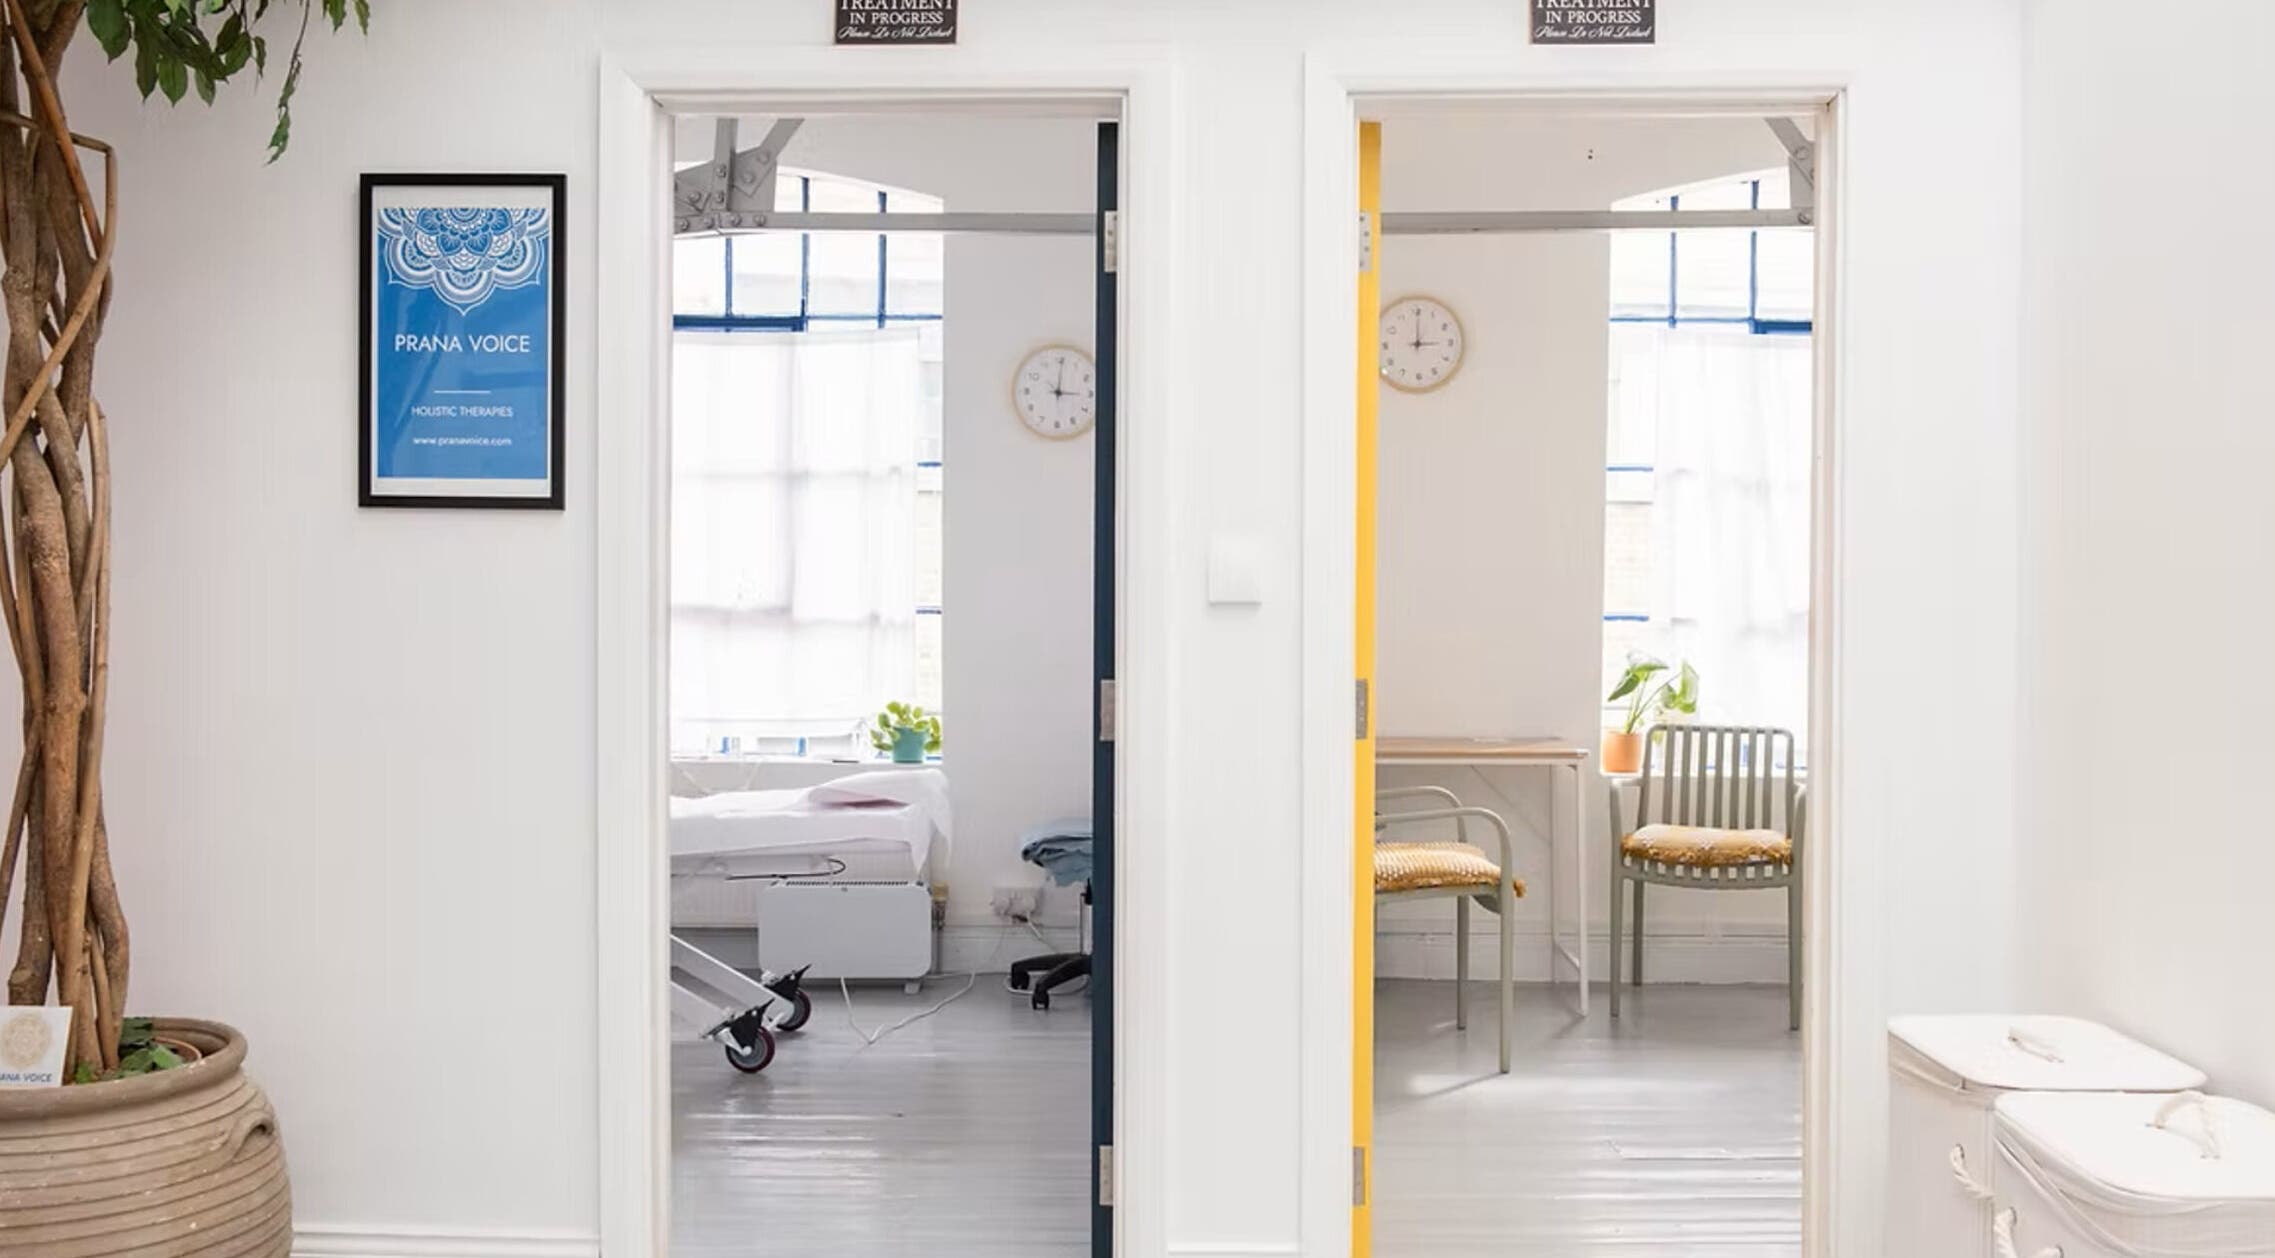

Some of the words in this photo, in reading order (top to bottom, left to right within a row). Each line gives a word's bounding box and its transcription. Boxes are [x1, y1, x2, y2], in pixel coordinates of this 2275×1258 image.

[840, 0, 953, 9] TREATMENT
[1536, 0, 1650, 8] TREATMENT
[850, 12, 865, 24] IN
[871, 11, 944, 24] PROGRESS
[1546, 11, 1561, 23] IN
[1568, 10, 1642, 23] PROGRESS
[394, 334, 463, 353] PRANA
[468, 335, 531, 353] VOICE
[411, 405, 457, 417] HOLISTIC
[460, 405, 514, 418] THERAPIES
[413, 436, 512, 447] www.pranavoice.com
[23, 1073, 52, 1082] VOICE
